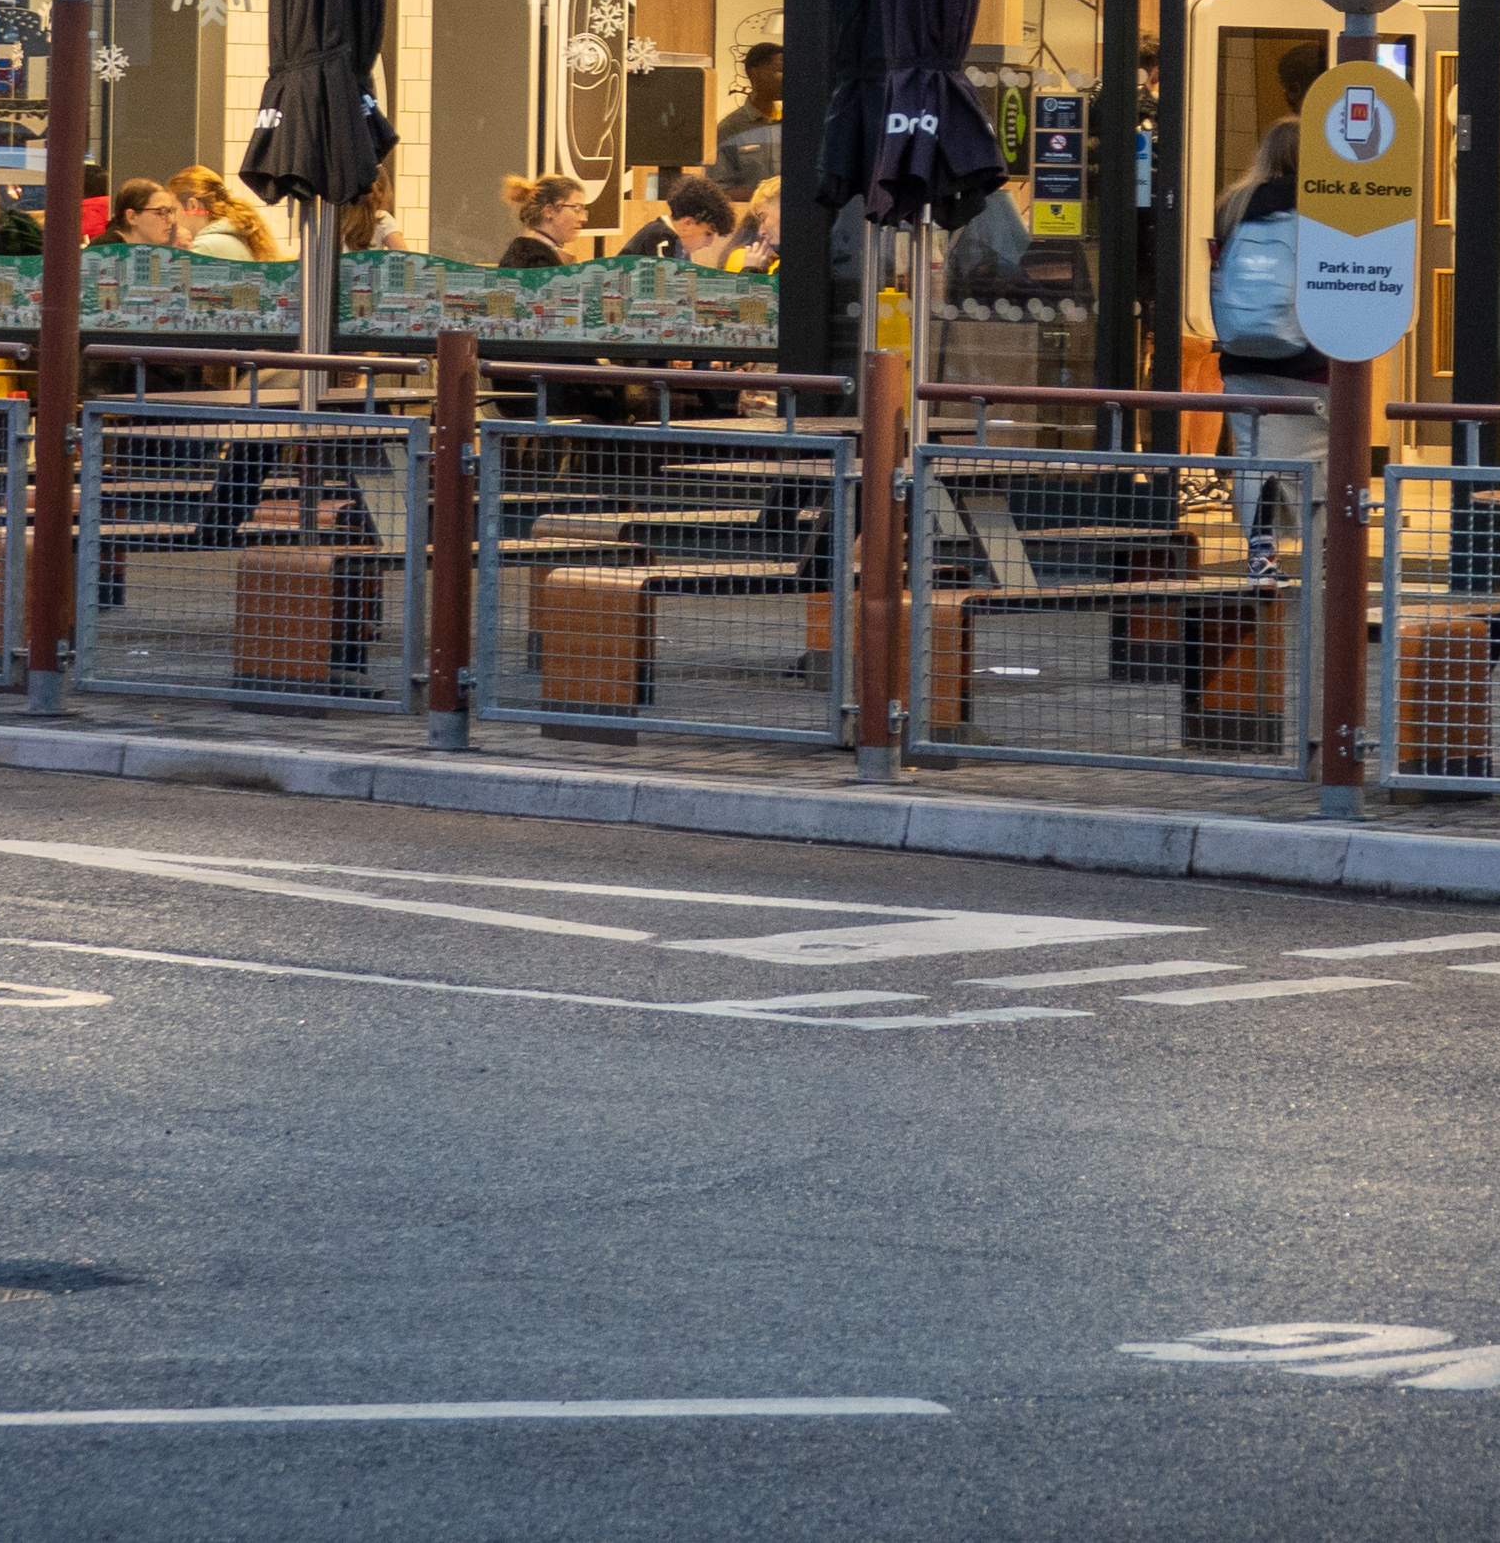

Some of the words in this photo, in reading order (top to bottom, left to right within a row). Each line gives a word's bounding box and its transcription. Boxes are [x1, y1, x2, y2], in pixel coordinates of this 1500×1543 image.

[1304, 179, 1346, 195] Click
[1350, 181, 1362, 195] &
[1366, 182, 1413, 197] Serve
[1319, 261, 1350, 275] Park
[1353, 262, 1365, 275] in
[1368, 264, 1393, 278] any
[1307, 279, 1376, 292] numbered
[1379, 280, 1404, 296] bay
